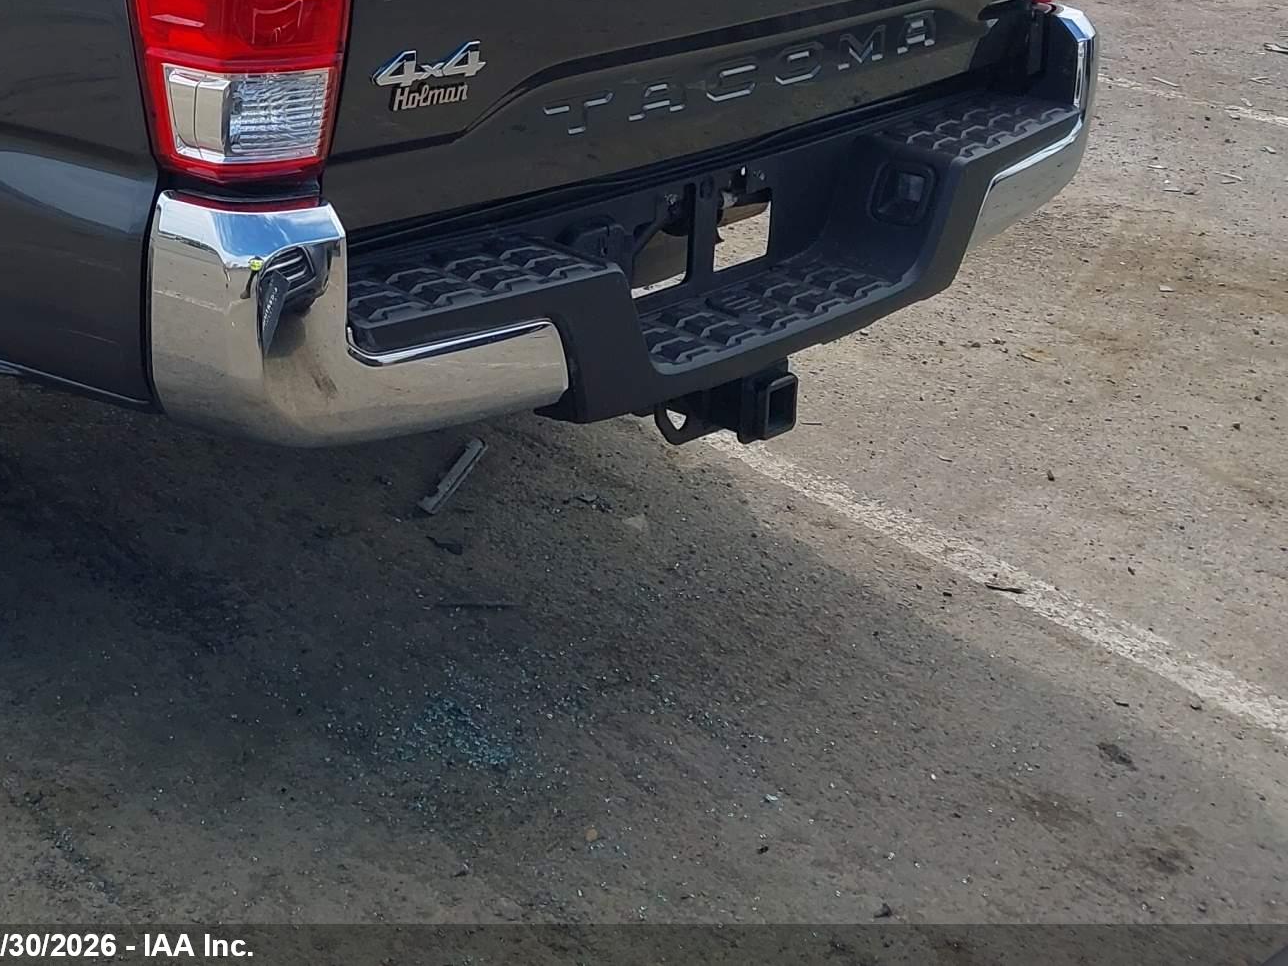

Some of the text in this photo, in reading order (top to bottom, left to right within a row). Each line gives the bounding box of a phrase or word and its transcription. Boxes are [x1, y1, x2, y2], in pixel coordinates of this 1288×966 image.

[371, 40, 486, 87] 4x4
[542, 9, 937, 135] TACOMA
[391, 82, 468, 111] Holman
